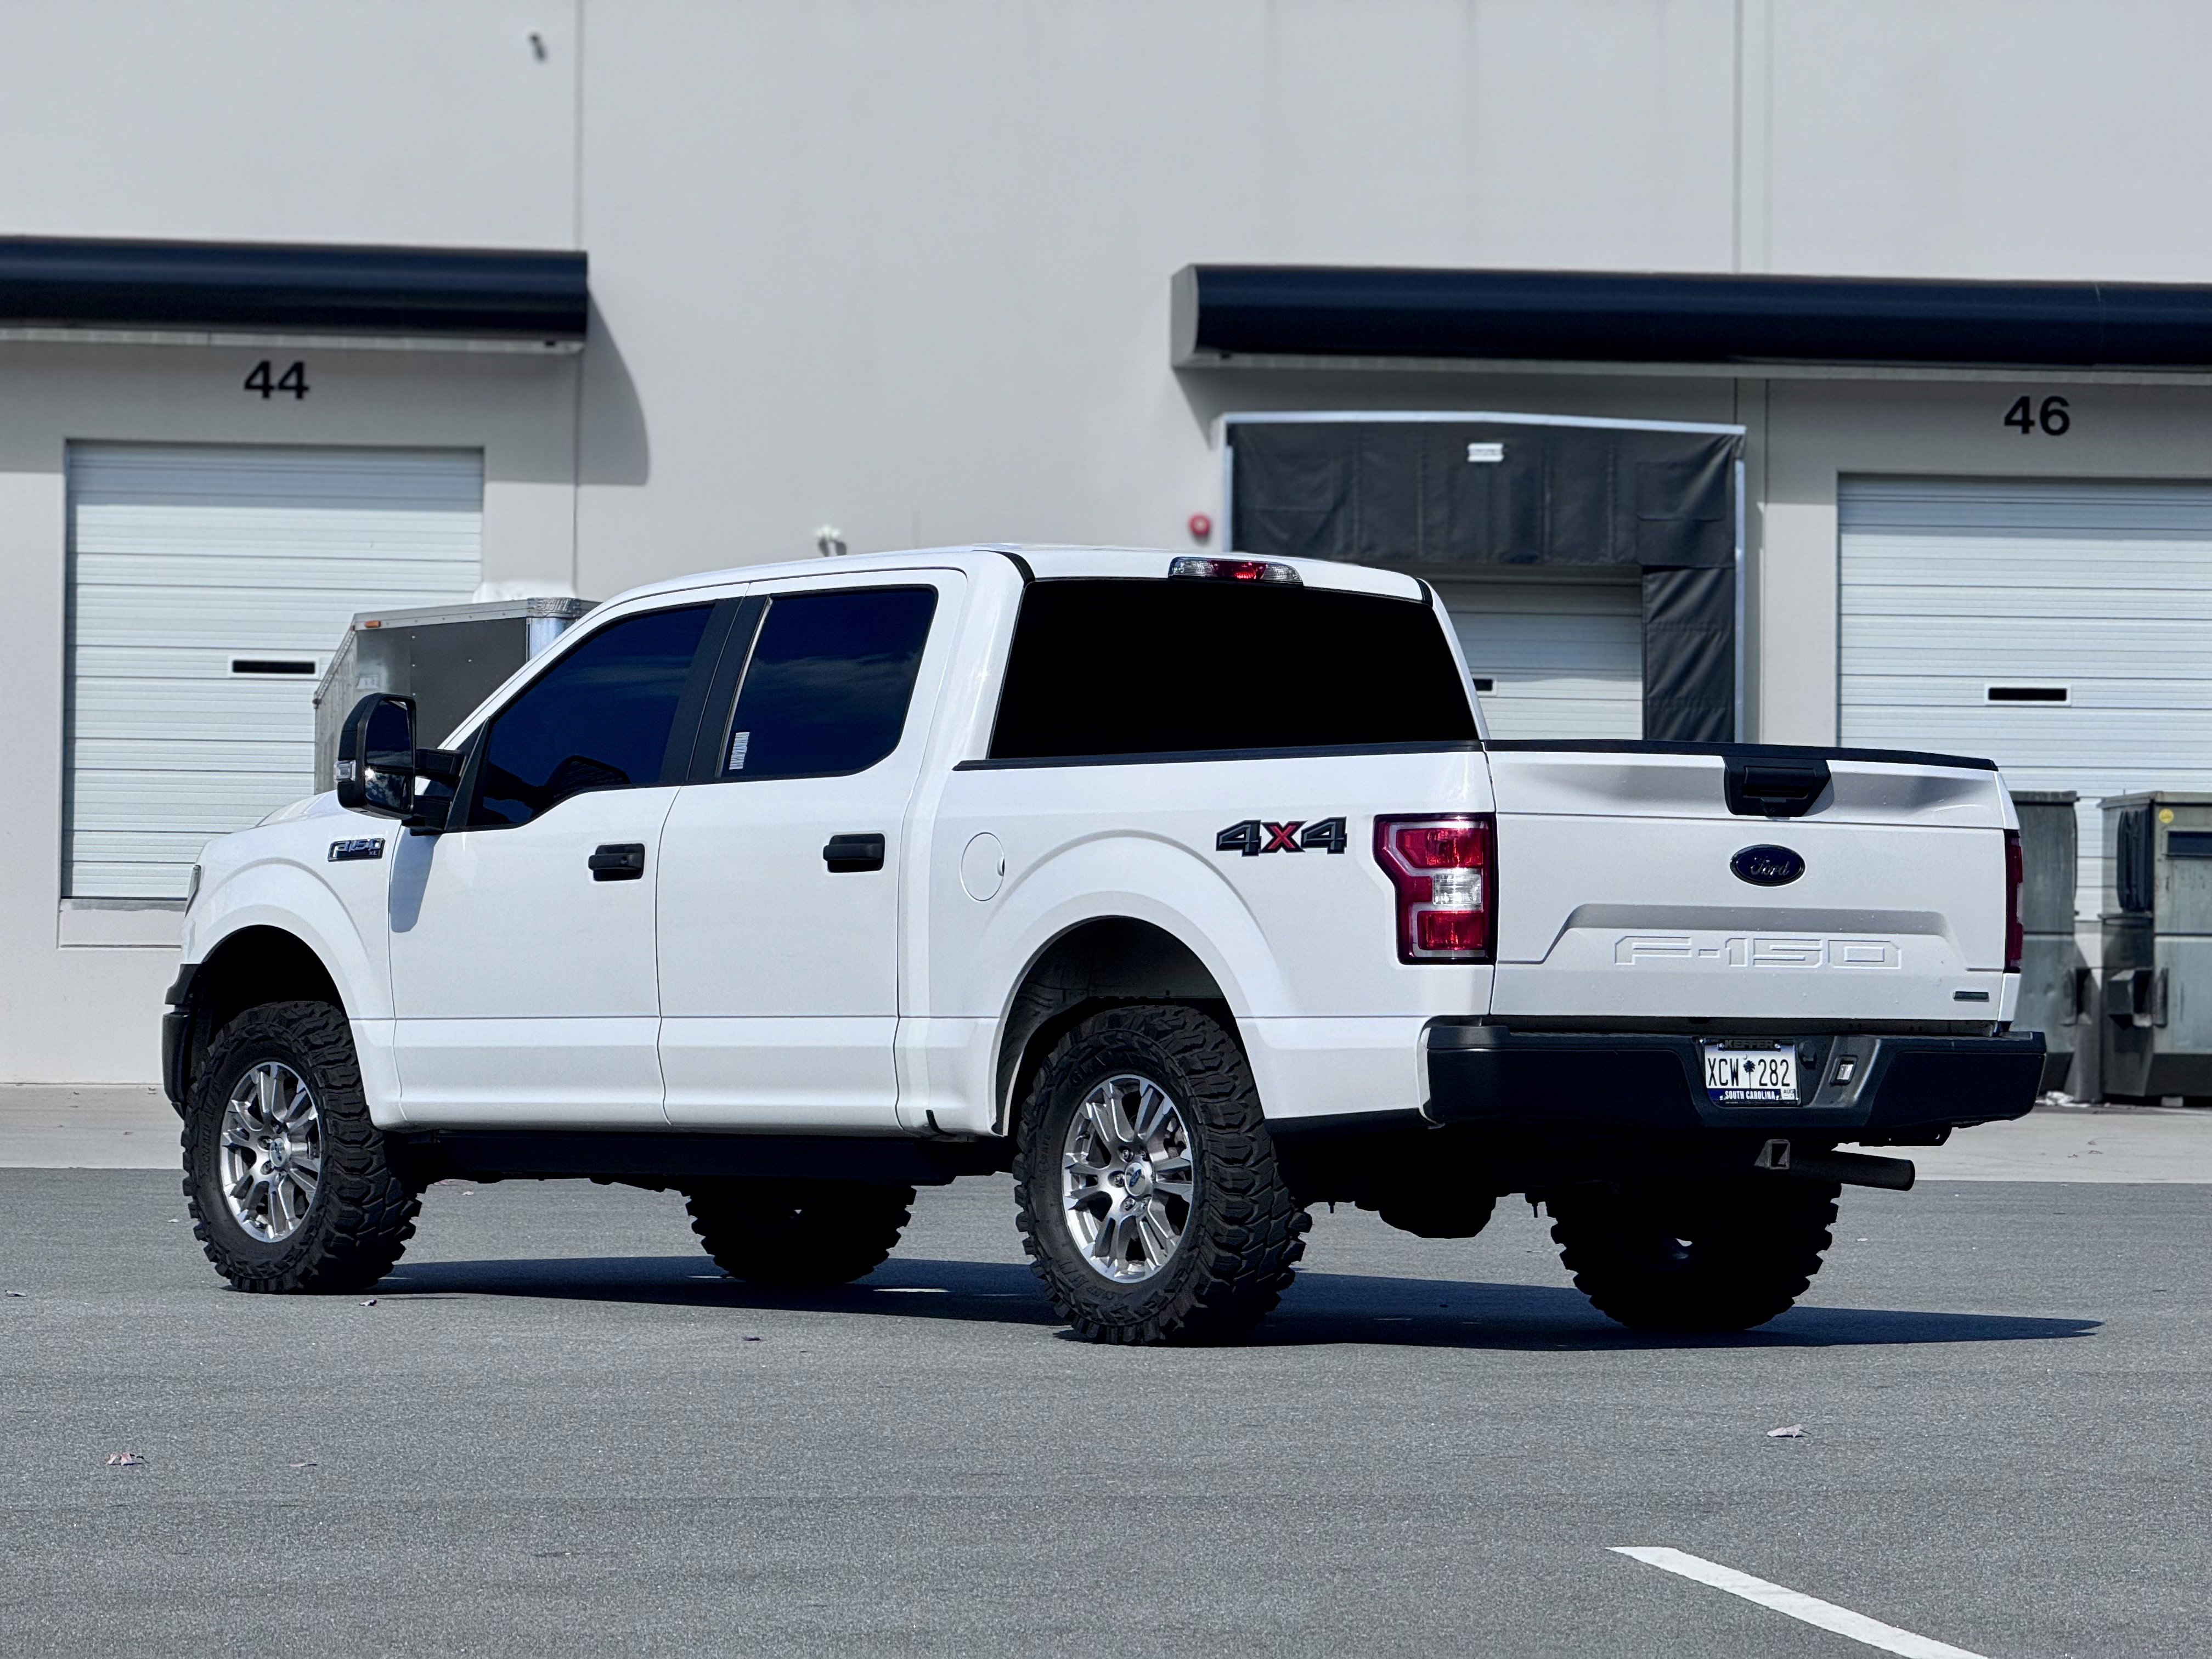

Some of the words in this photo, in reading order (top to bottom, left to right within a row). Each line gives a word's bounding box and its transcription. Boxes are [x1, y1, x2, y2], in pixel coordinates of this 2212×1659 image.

[245, 360, 309, 399] 44
[2004, 395, 2070, 436] 46
[1750, 856, 1791, 876] Ford
[1614, 935, 1901, 970] F-150
[1707, 1058, 1739, 1086] XCW
[1758, 1059, 1790, 1086] 282
[1725, 1090, 1745, 1099] SOUTH
[1746, 1090, 1775, 1099] CAROLINA
